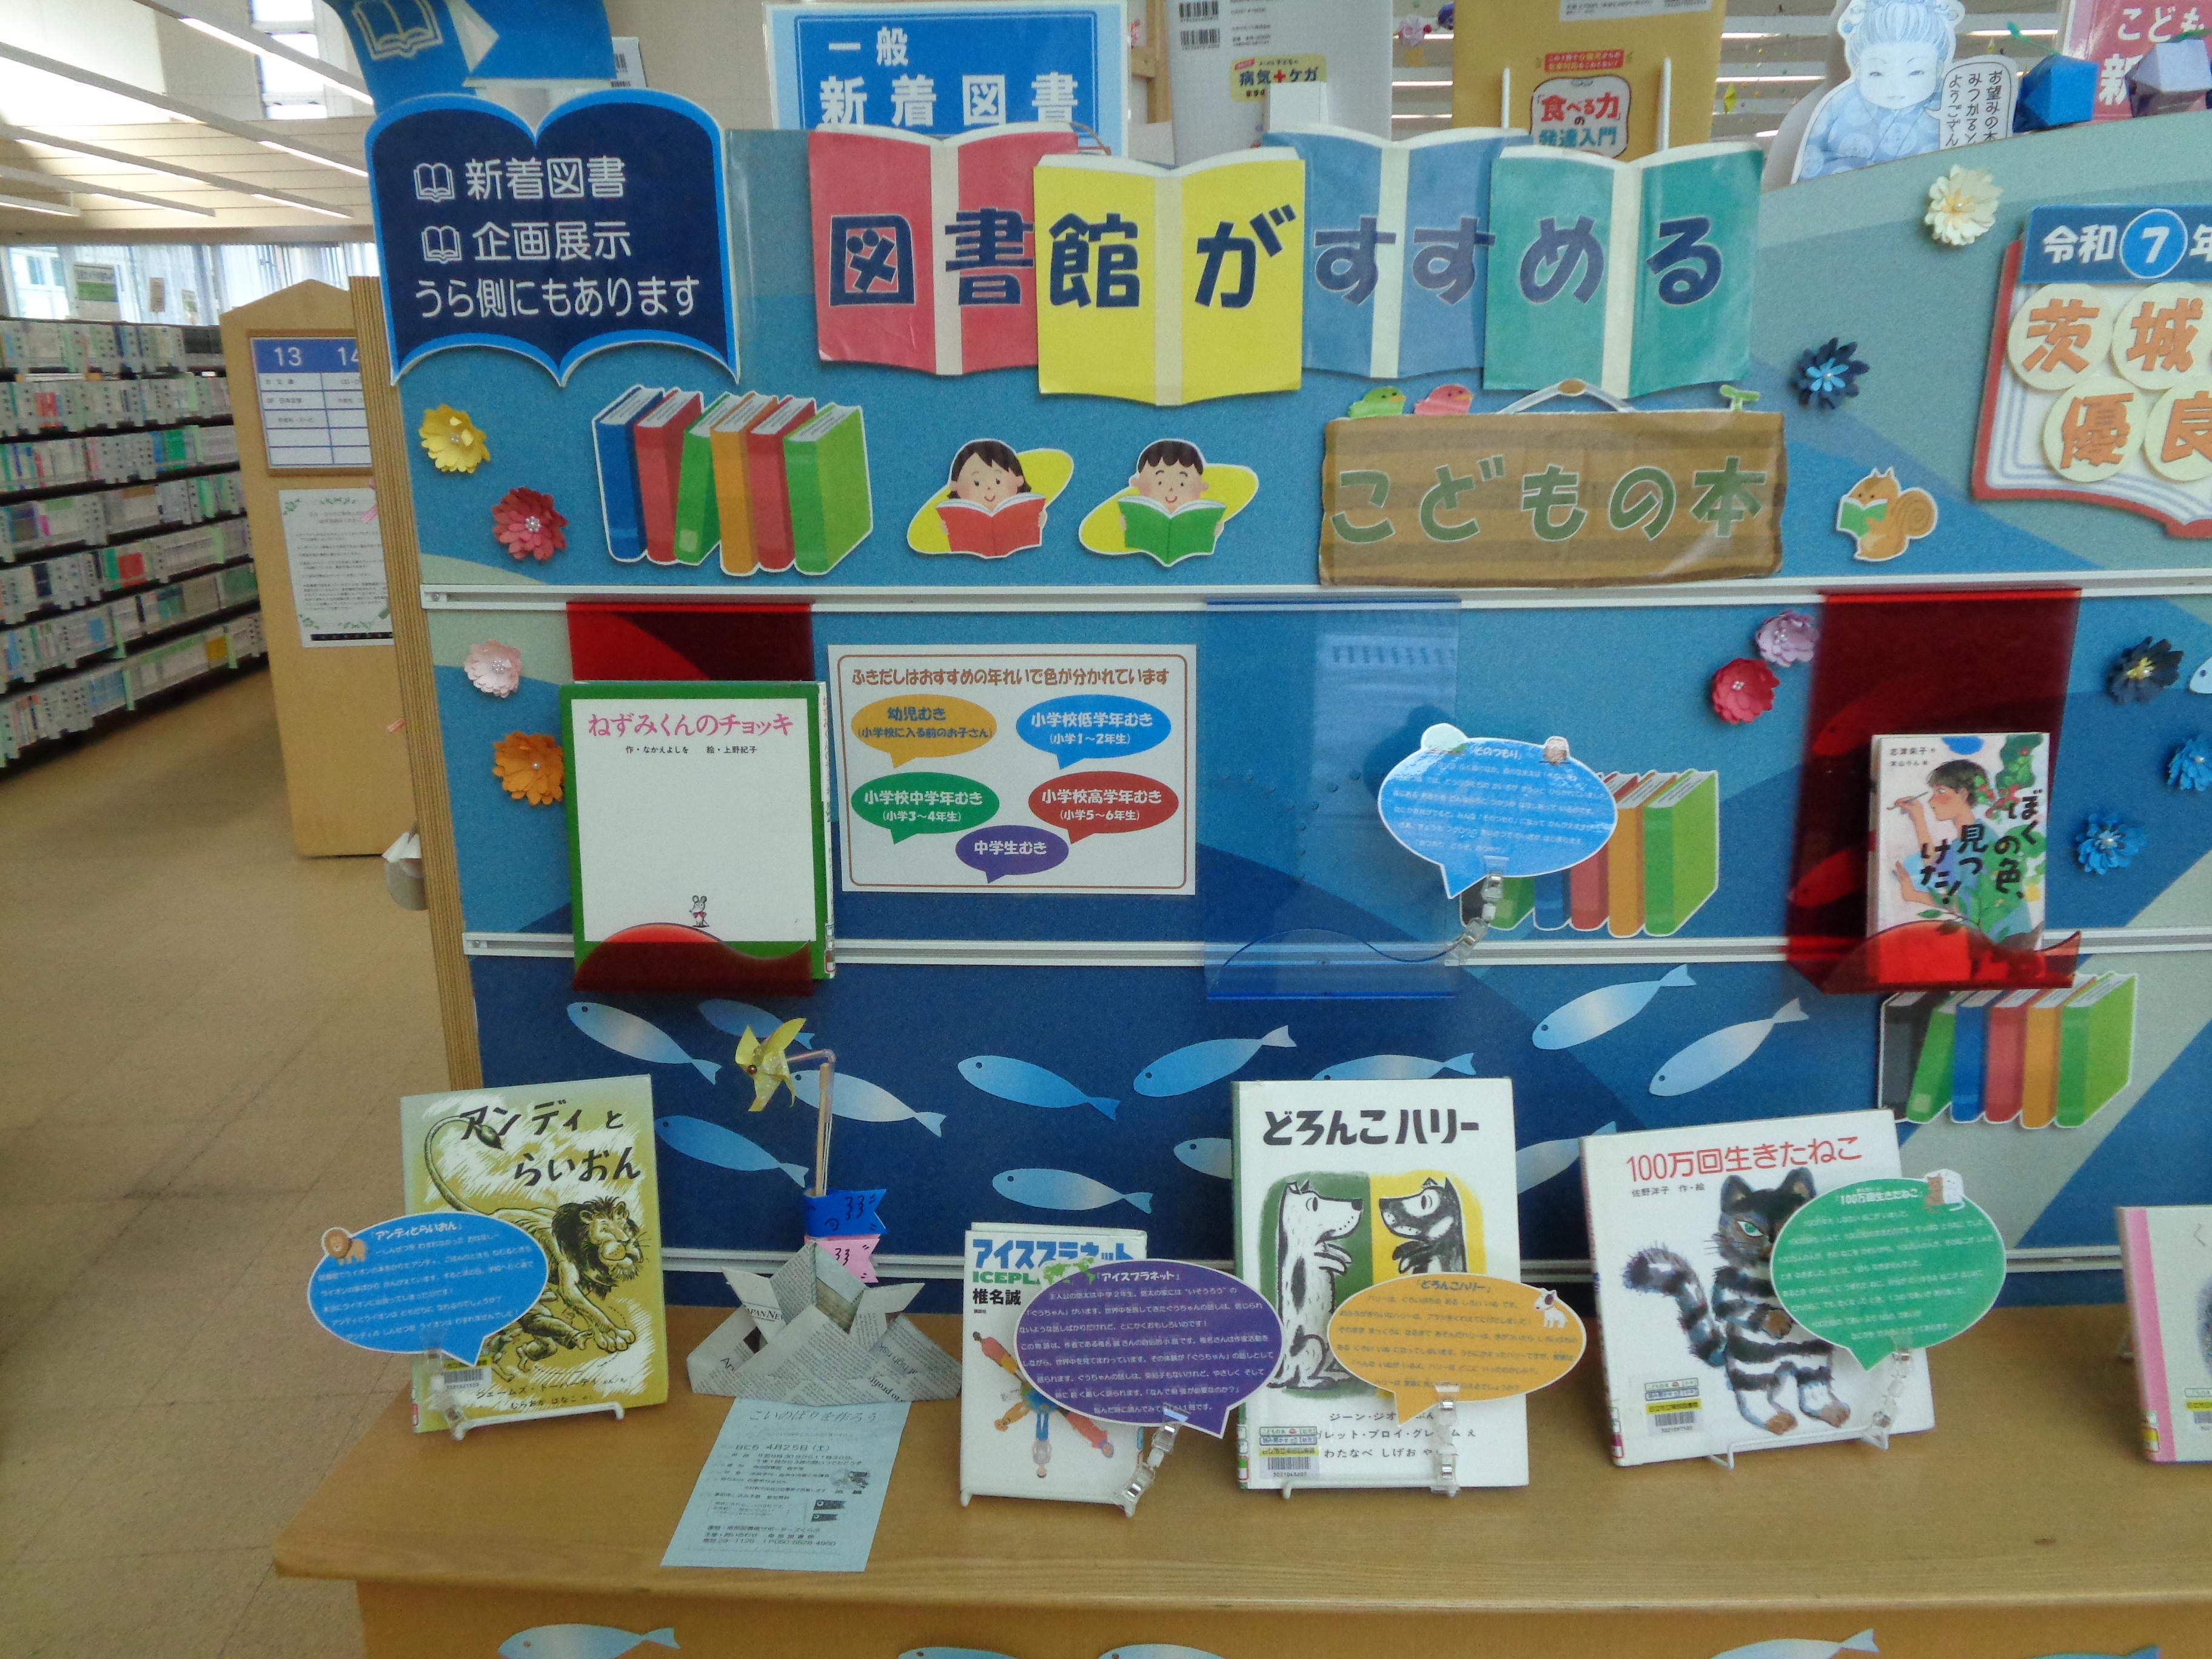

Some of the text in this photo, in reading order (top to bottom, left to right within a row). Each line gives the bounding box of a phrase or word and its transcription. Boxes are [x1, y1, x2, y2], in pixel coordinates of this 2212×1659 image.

[829, 26, 909, 67] 一般
[820, 72, 1078, 127] 新着図書
[1574, 116, 1585, 126] の
[465, 155, 626, 200] 新着図書
[472, 221, 631, 261] 企画展示
[415, 276, 700, 318] うら側にもあります
[2022, 297, 2203, 373] 茨城
[274, 347, 302, 366] 13
[2060, 390, 2212, 469] 優良
[1331, 454, 1766, 543] こどもの本
[852, 668, 1169, 686] ふきだしはおすすめの年れいで色が分かれています
[886, 706, 947, 721] 幼児むき
[1031, 711, 1153, 728] 小学校低学年むき
[588, 712, 793, 736] ねずみくんのチョッキ
[626, 745, 689, 754] 作・なかえよしを
[864, 789, 983, 806] 小学校中学年むき
[1042, 789, 1162, 805] 小学校高学年むき
[974, 840, 1047, 856] 中学生むき
[1262, 1108, 1480, 1146] どろんこハリー
[514, 1147, 641, 1187] らいおん
[1626, 1136, 1862, 1182] 100万回生きたねこ
[973, 1271, 1041, 1284] ICEPL
[973, 1289, 1021, 1305] 椎名誠
[1330, 1413, 1396, 1421] ジーン・ジオ
[1318, 1429, 1460, 1439] レット・ブロイ・グレム
[1324, 1449, 1372, 1458] わたなべ
[1382, 1448, 1416, 1458] しげお
